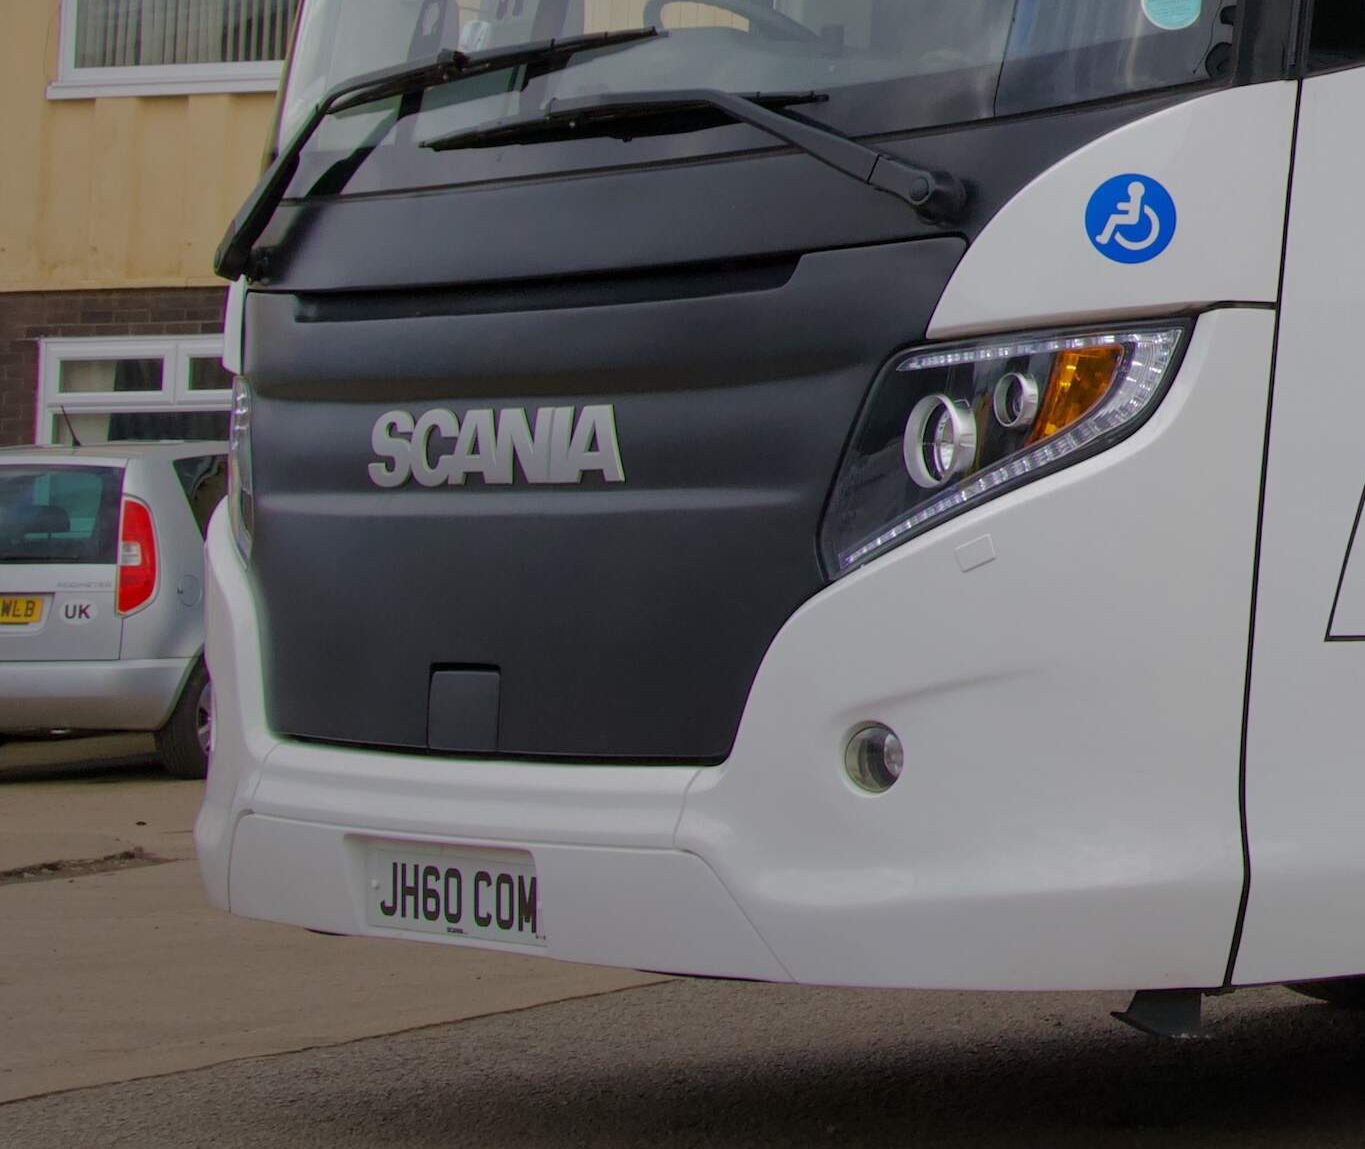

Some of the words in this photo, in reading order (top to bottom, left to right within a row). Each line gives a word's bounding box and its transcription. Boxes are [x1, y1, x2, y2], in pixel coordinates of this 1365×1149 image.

[367, 403, 626, 488] SCANIA
[0, 599, 37, 618] WLB
[64, 603, 92, 620] UK
[380, 861, 463, 924] JH60
[473, 870, 538, 934] COM
